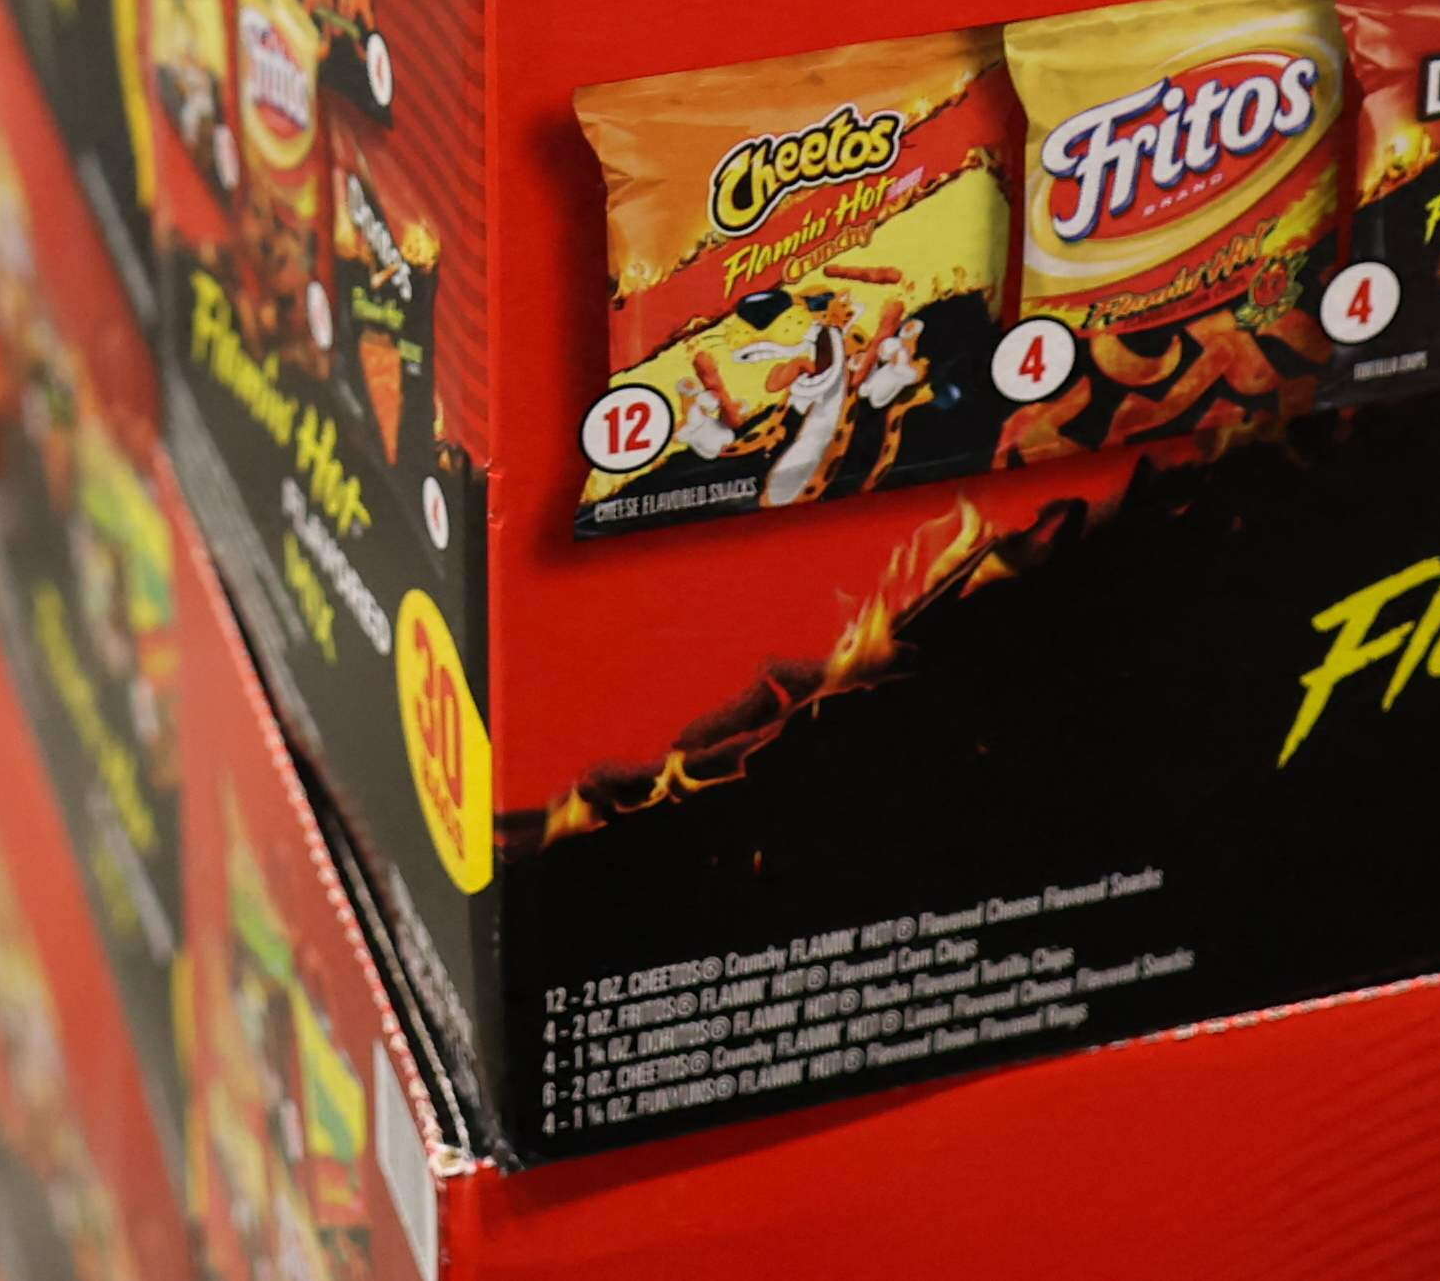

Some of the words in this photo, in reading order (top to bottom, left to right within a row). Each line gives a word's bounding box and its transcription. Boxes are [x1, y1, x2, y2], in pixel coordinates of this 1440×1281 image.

[708, 102, 903, 237] Cheetos
[1041, 55, 1317, 243] Fritos
[1346, 277, 1374, 325] 4
[1018, 335, 1046, 384] 4
[602, 401, 651, 456] 12
